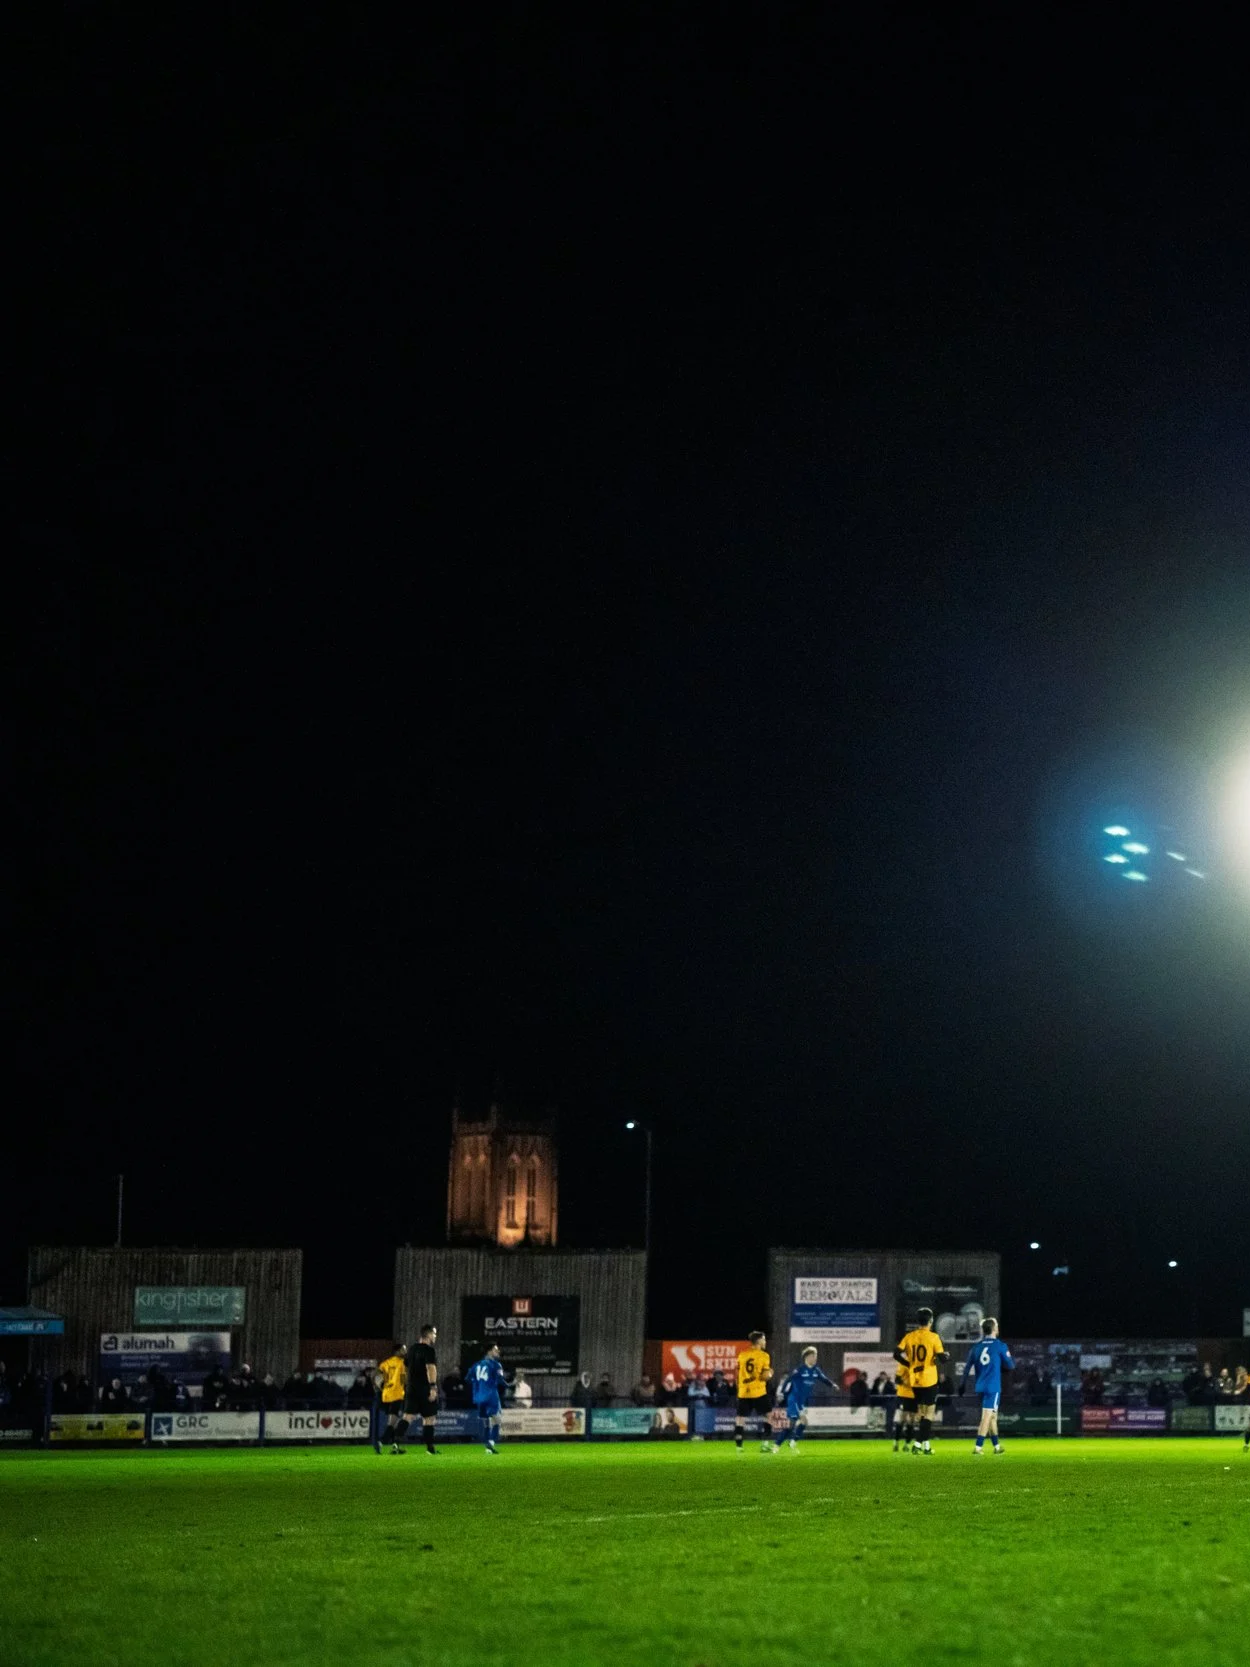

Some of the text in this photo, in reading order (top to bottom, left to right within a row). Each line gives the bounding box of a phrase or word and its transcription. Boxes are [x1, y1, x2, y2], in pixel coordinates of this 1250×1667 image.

[800, 1291, 873, 1301] REMOVALS
[485, 1317, 558, 1329] EASTERN
[122, 1336, 175, 1350] alumah
[706, 1346, 737, 1357] SUN
[911, 1344, 927, 1362] 10
[979, 1347, 991, 1366] 6
[475, 1364, 489, 1382] 14
[745, 1358, 755, 1374] 6
[176, 1416, 209, 1428] GRC
